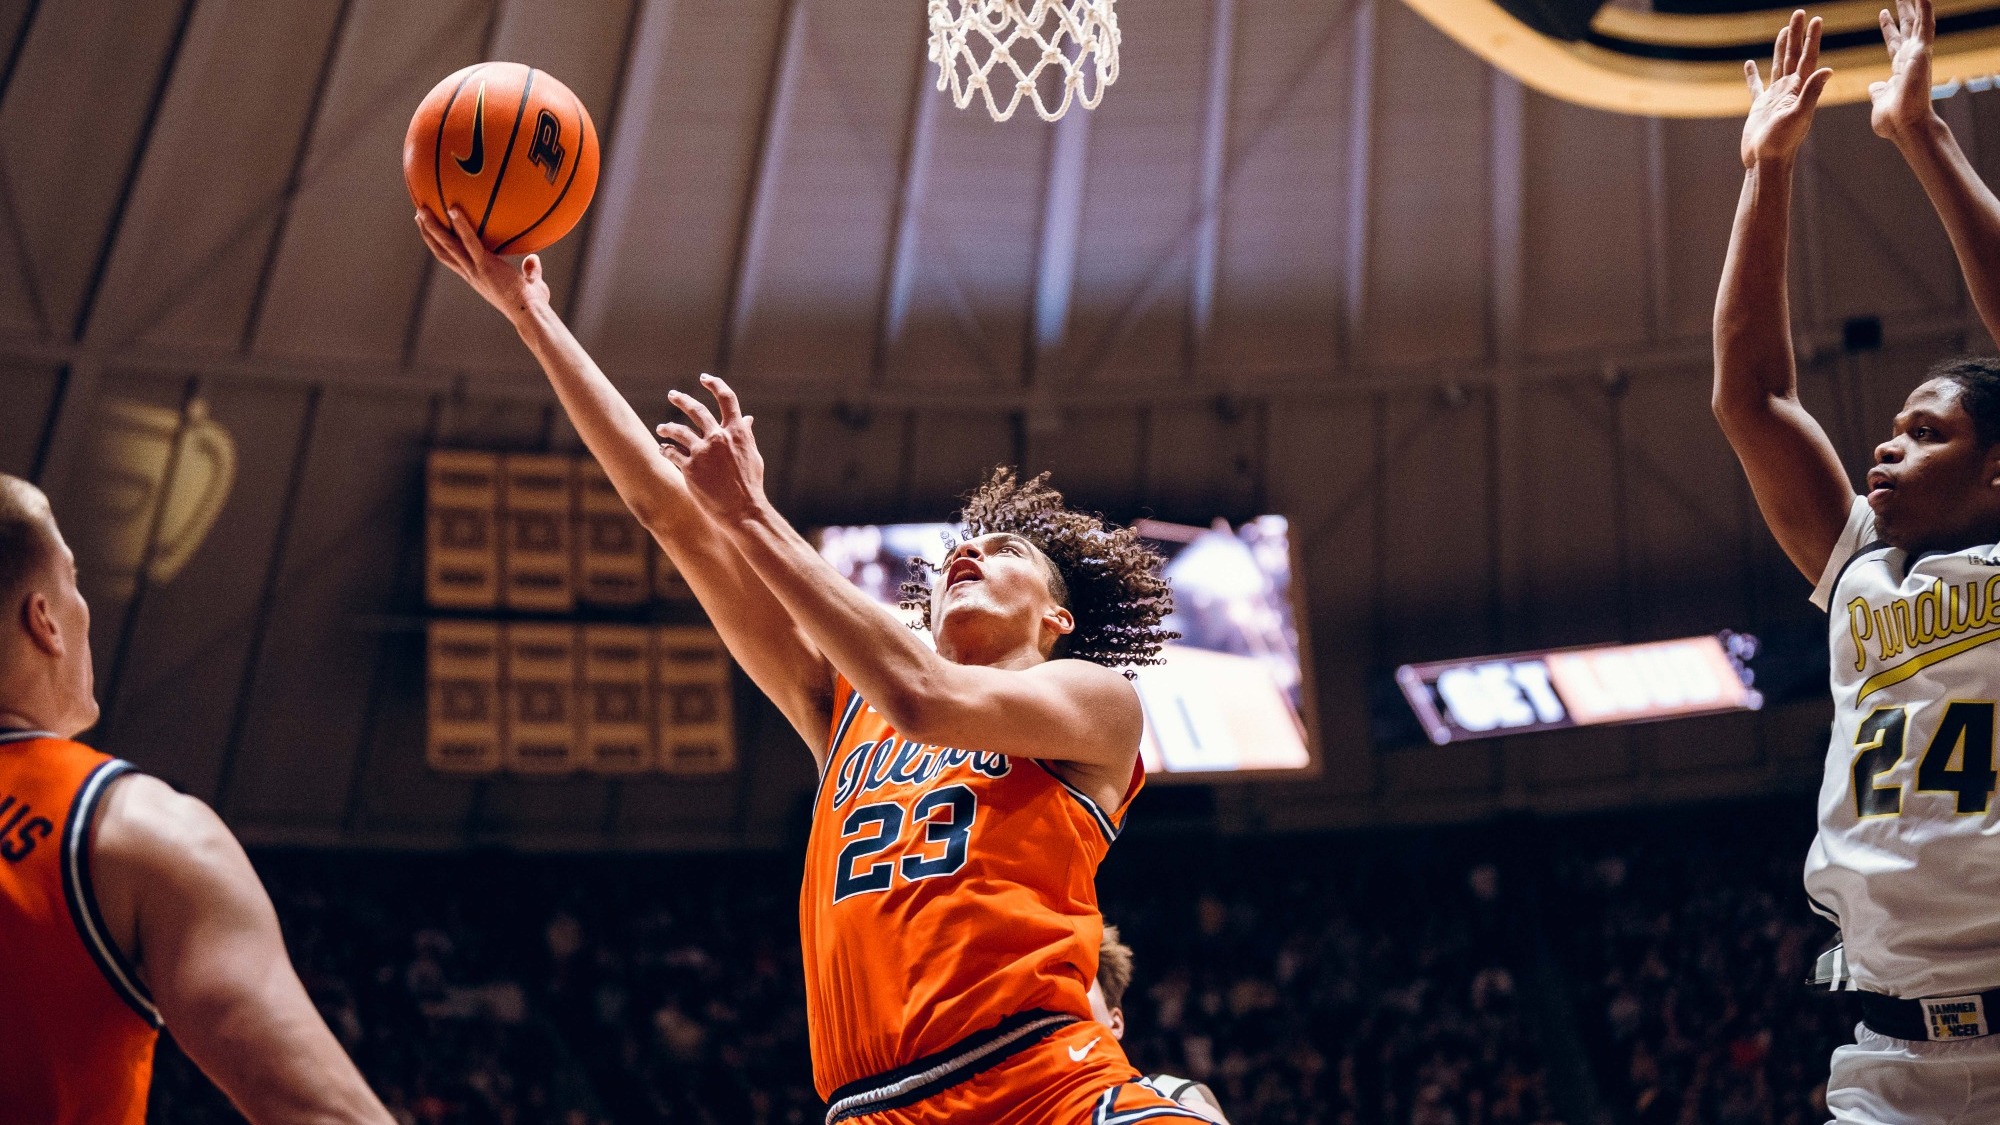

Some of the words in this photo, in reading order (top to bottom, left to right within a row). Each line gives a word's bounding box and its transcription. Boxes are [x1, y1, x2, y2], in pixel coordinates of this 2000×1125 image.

[528, 108, 565, 185] P
[1851, 699, 1998, 820] 24
[833, 783, 978, 905] 23
[1927, 1002, 1977, 1015] HAMMER
[1930, 1013, 1959, 1026] DWN
